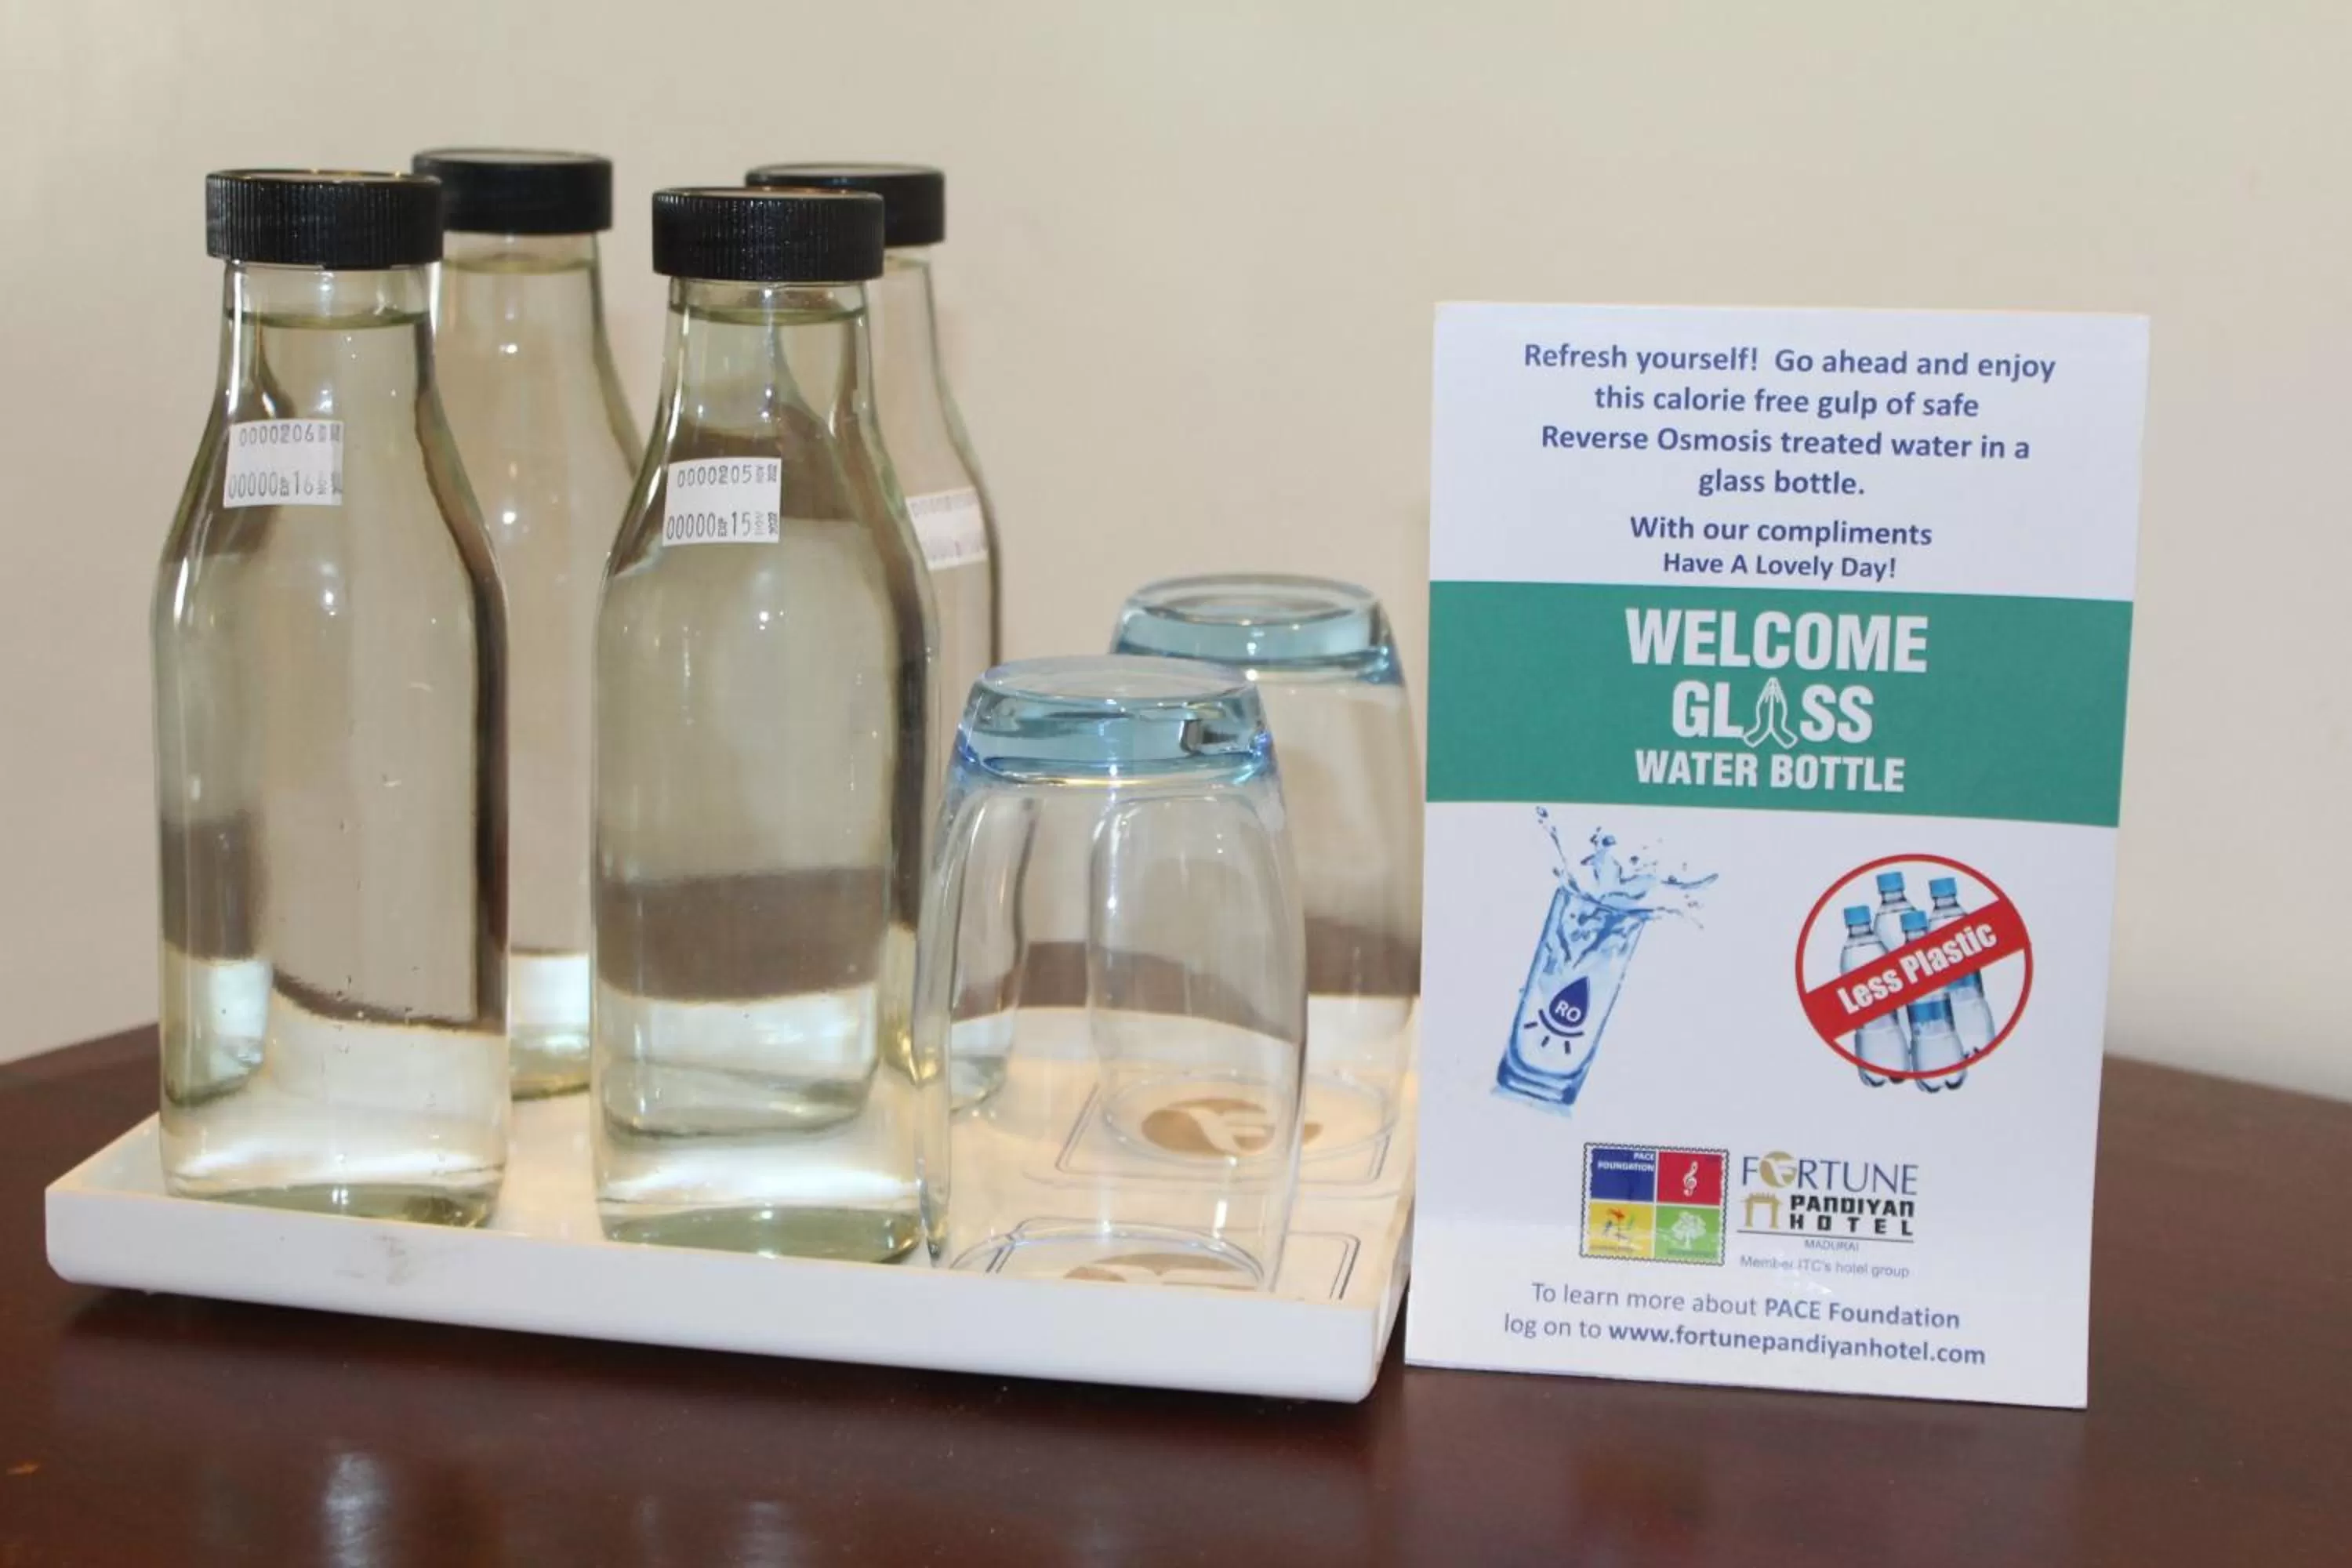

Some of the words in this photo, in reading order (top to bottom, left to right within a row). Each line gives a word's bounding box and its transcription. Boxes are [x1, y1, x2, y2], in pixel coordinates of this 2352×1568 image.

[1525, 343, 1628, 368] Refresh
[1635, 347, 1757, 375] yourself!
[1775, 349, 1813, 372] Go
[1821, 349, 1907, 375] ahead
[1916, 352, 1969, 376] and
[1977, 354, 2056, 383] enjoy
[1594, 384, 1645, 409] this
[1653, 386, 1746, 412] calorie
[1754, 388, 1809, 413] free
[1817, 390, 1878, 420] gulp
[1886, 390, 1916, 416] of
[1922, 392, 1979, 417] safe
[1542, 425, 1649, 450] Reverse
[1657, 427, 1772, 452] Osmosis
[1780, 431, 1882, 456] treated
[1890, 435, 1973, 458] water
[1981, 434, 2005, 459] in
[2014, 441, 2030, 459] a
[1698, 467, 1766, 497] glass
[1774, 470, 1864, 495] bottle.
[1630, 516, 1694, 539] With
[1703, 523, 1750, 540] our
[1757, 520, 1933, 548] compliments
[1664, 552, 1724, 574] Have
[1730, 554, 1748, 575] A
[1755, 554, 1835, 582] Lovely
[1841, 557, 1896, 583] Day!
[1624, 608, 1929, 673] WELCOME
[1635, 749, 1759, 788] WATER
[1769, 753, 1905, 793] BOTTLE
[1837, 968, 1904, 1014] Less
[1899, 924, 1997, 984] Plastic
[1555, 1000, 1581, 1022] RO
[1598, 1161, 1654, 1171] FOUNDATION
[1790, 1214, 1912, 1236] HOTEL
[1805, 1239, 1859, 1251] MADURAI
[1740, 1254, 1793, 1269] Member
[1836, 1262, 1867, 1274] hotel
[1871, 1265, 1909, 1279] group
[1531, 1282, 1556, 1303] To
[1563, 1283, 1619, 1305] learn
[1626, 1292, 1685, 1312] more
[1692, 1293, 1757, 1316] about
[1765, 1298, 1821, 1320] PACE
[1829, 1302, 1960, 1329] Foundation
[1504, 1312, 1537, 1340] log
[1543, 1320, 1571, 1338] on
[1579, 1320, 1602, 1339] to
[1608, 1321, 1986, 1365] www.fortunepandiyanhotel.com
